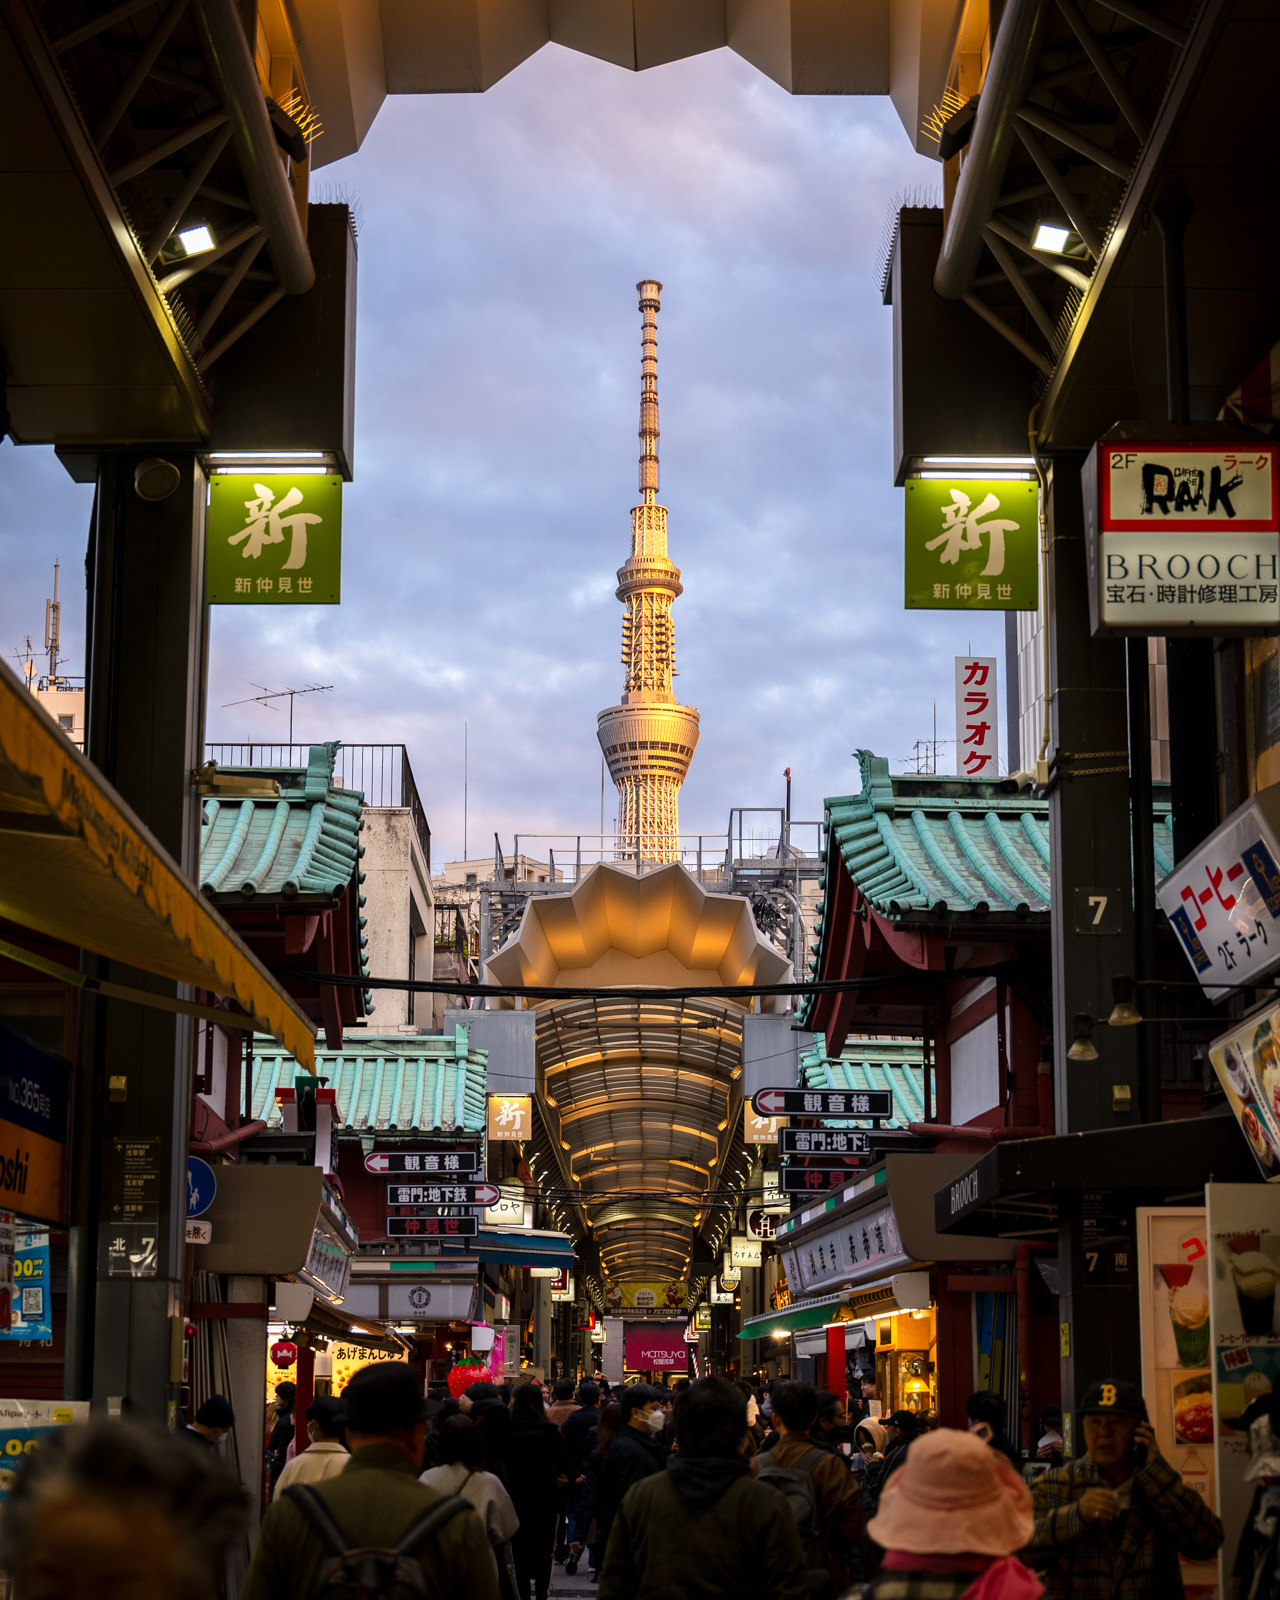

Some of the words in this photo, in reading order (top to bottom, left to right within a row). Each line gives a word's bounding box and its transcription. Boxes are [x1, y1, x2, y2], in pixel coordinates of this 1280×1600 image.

[1112, 454, 1138, 469] 2F
[1224, 455, 1268, 471] ラーク
[227, 483, 323, 570] 新
[925, 488, 1020, 576] 新
[1106, 554, 1278, 580] BROOCH
[234, 577, 313, 593] 新仲見世
[933, 583, 1012, 600] 新仲見世
[1106, 584, 1278, 604] 宝石・時計修理工房
[962, 662, 992, 774] カラオケ
[1181, 862, 1244, 931] コーヒー
[1089, 896, 1107, 925] 7
[1236, 919, 1268, 958] ラーク
[1217, 940, 1237, 971] 2F
[803, 1094, 870, 1112] 観音様
[494, 1100, 526, 1130] 新
[404, 1155, 460, 1171] 観音様
[397, 1187, 468, 1203] 雷門:地下鉄
[951, 1169, 978, 1215] BROOCH
[404, 1219, 460, 1234] 仲見世
[112, 1237, 126, 1251] 北
[142, 1237, 155, 1257] 7
[1085, 1252, 1099, 1272] 7
[1114, 1252, 1128, 1267] 南
[1223, 1348, 1249, 1368] 特製
[1098, 1384, 1117, 1406] B
